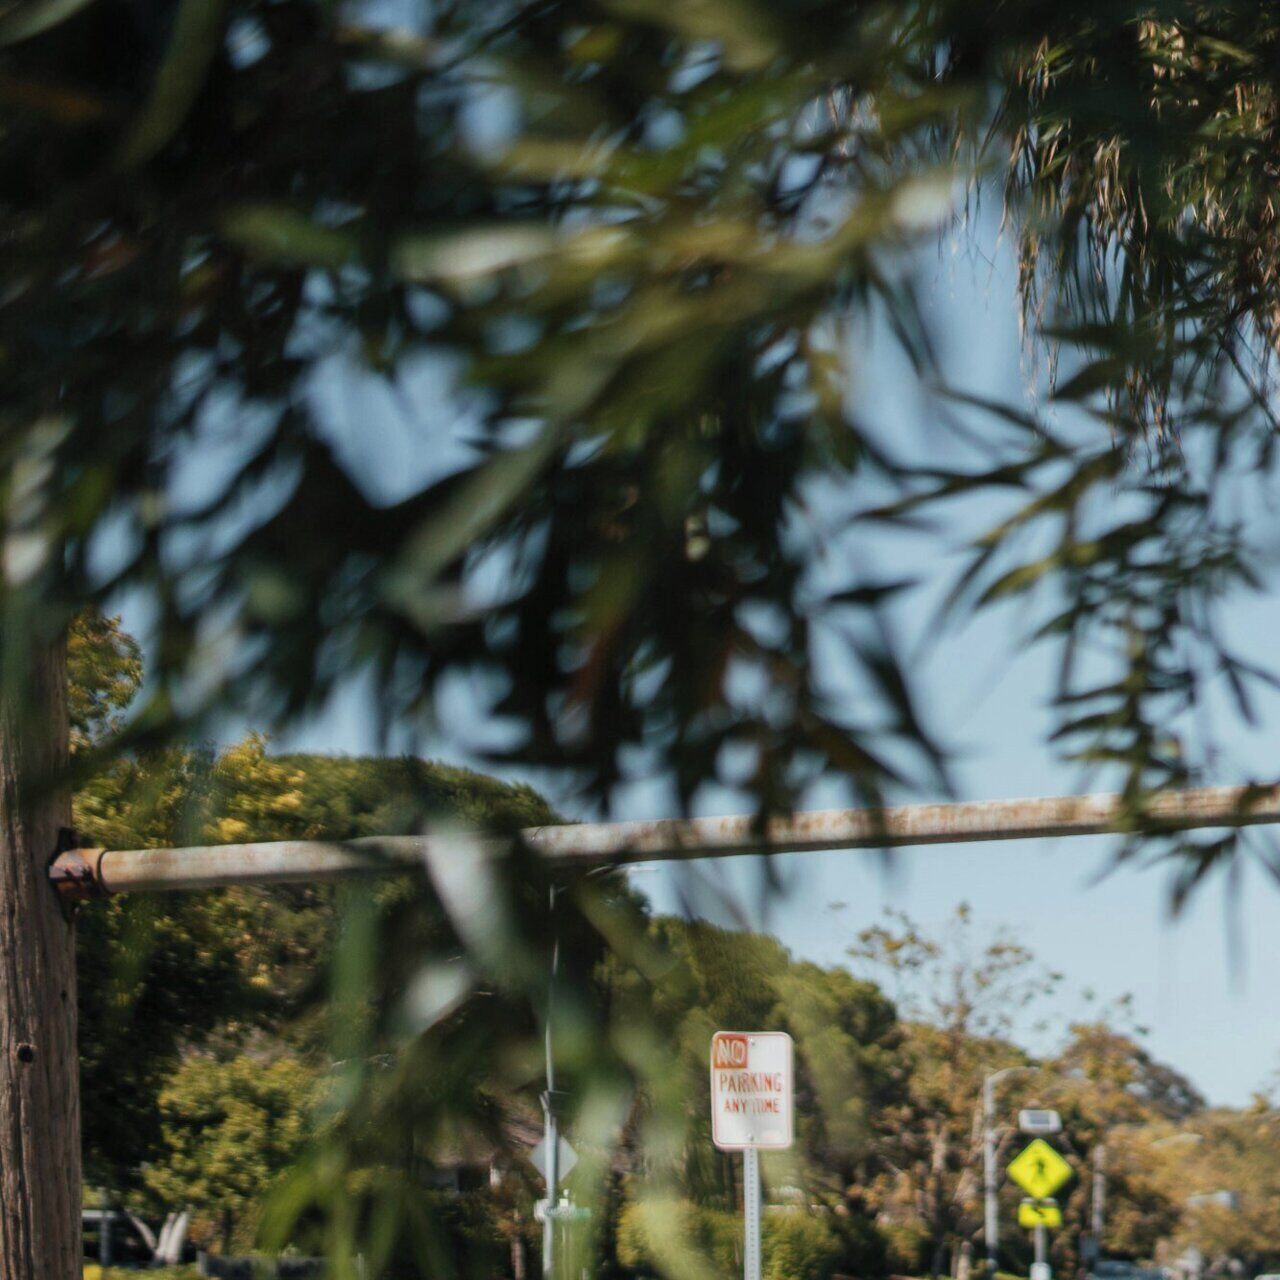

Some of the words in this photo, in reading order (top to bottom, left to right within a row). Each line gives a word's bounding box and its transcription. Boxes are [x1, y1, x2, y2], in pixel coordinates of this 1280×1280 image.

[717, 1039, 746, 1065] NO
[720, 1072, 782, 1093] PARKING
[724, 1099, 746, 1113] ANY
[751, 1099, 780, 1113] TIME
